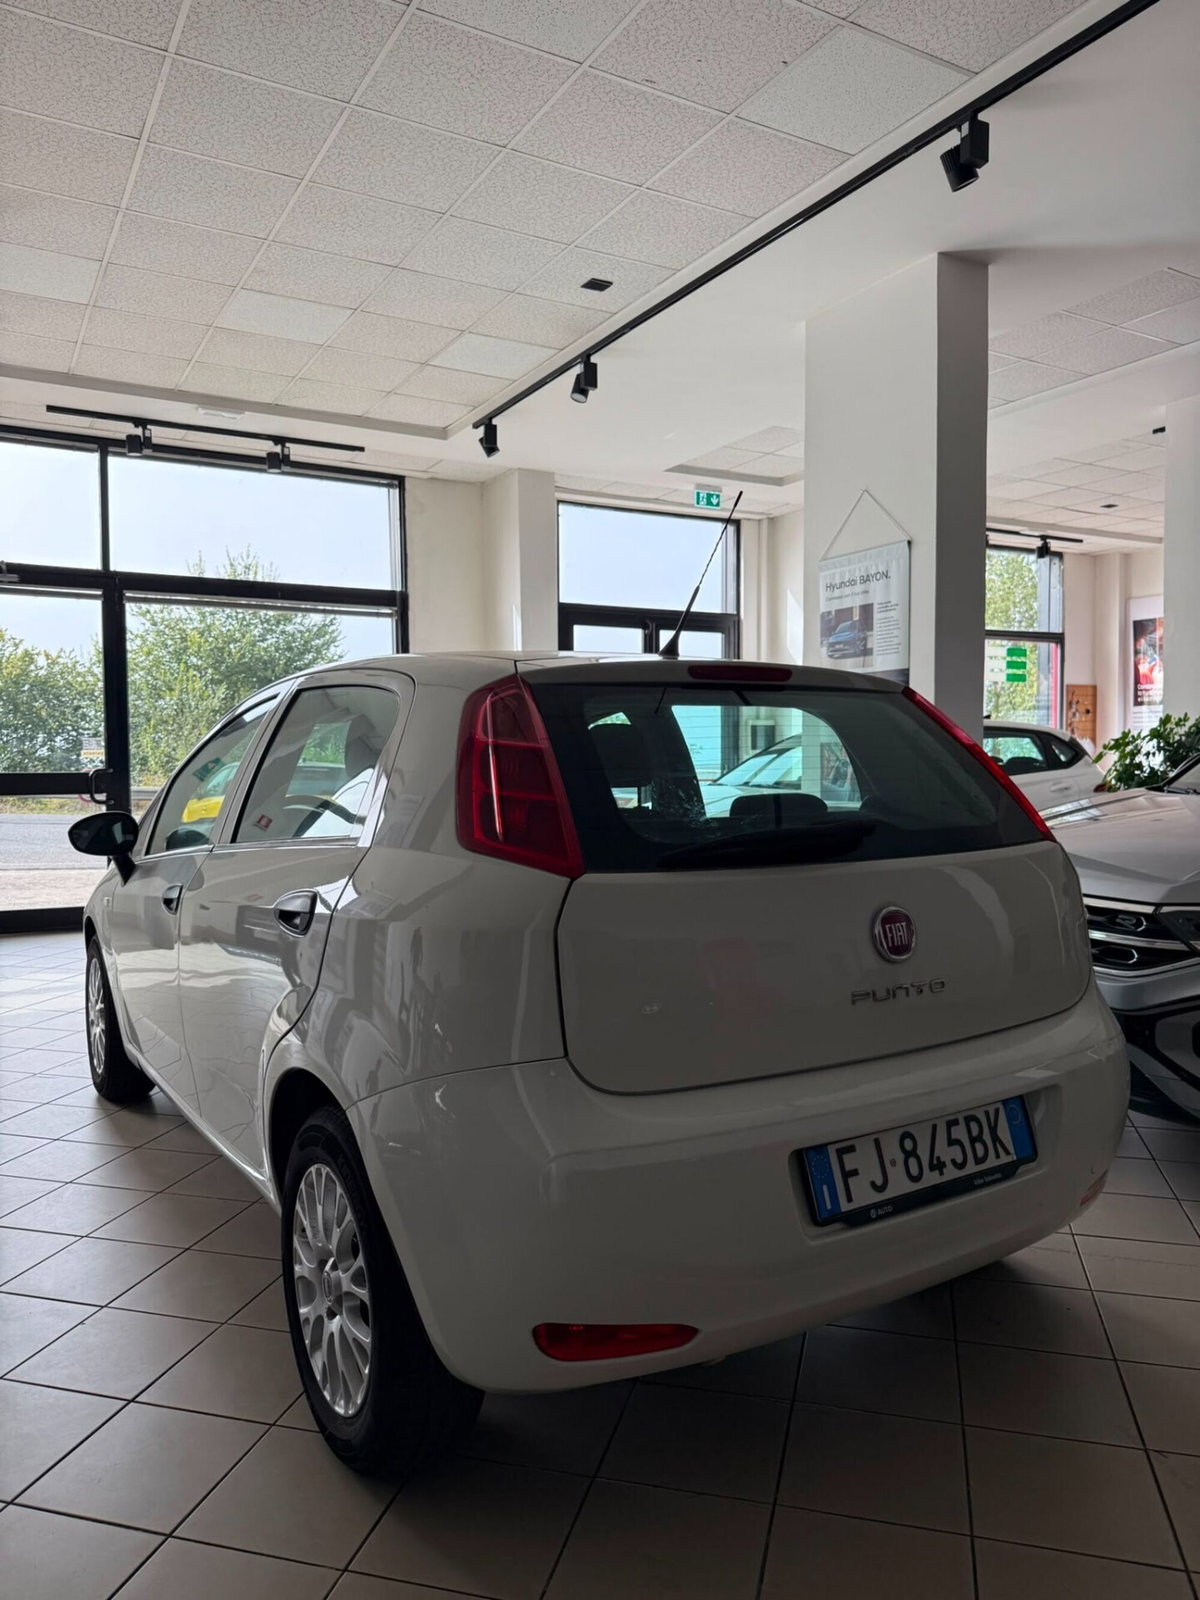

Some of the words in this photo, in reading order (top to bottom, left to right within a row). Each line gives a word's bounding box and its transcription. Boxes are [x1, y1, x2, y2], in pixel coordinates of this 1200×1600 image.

[825, 577, 858, 592] Hyundai
[860, 570, 891, 585] BAYON.
[885, 922, 908, 947] FIAT
